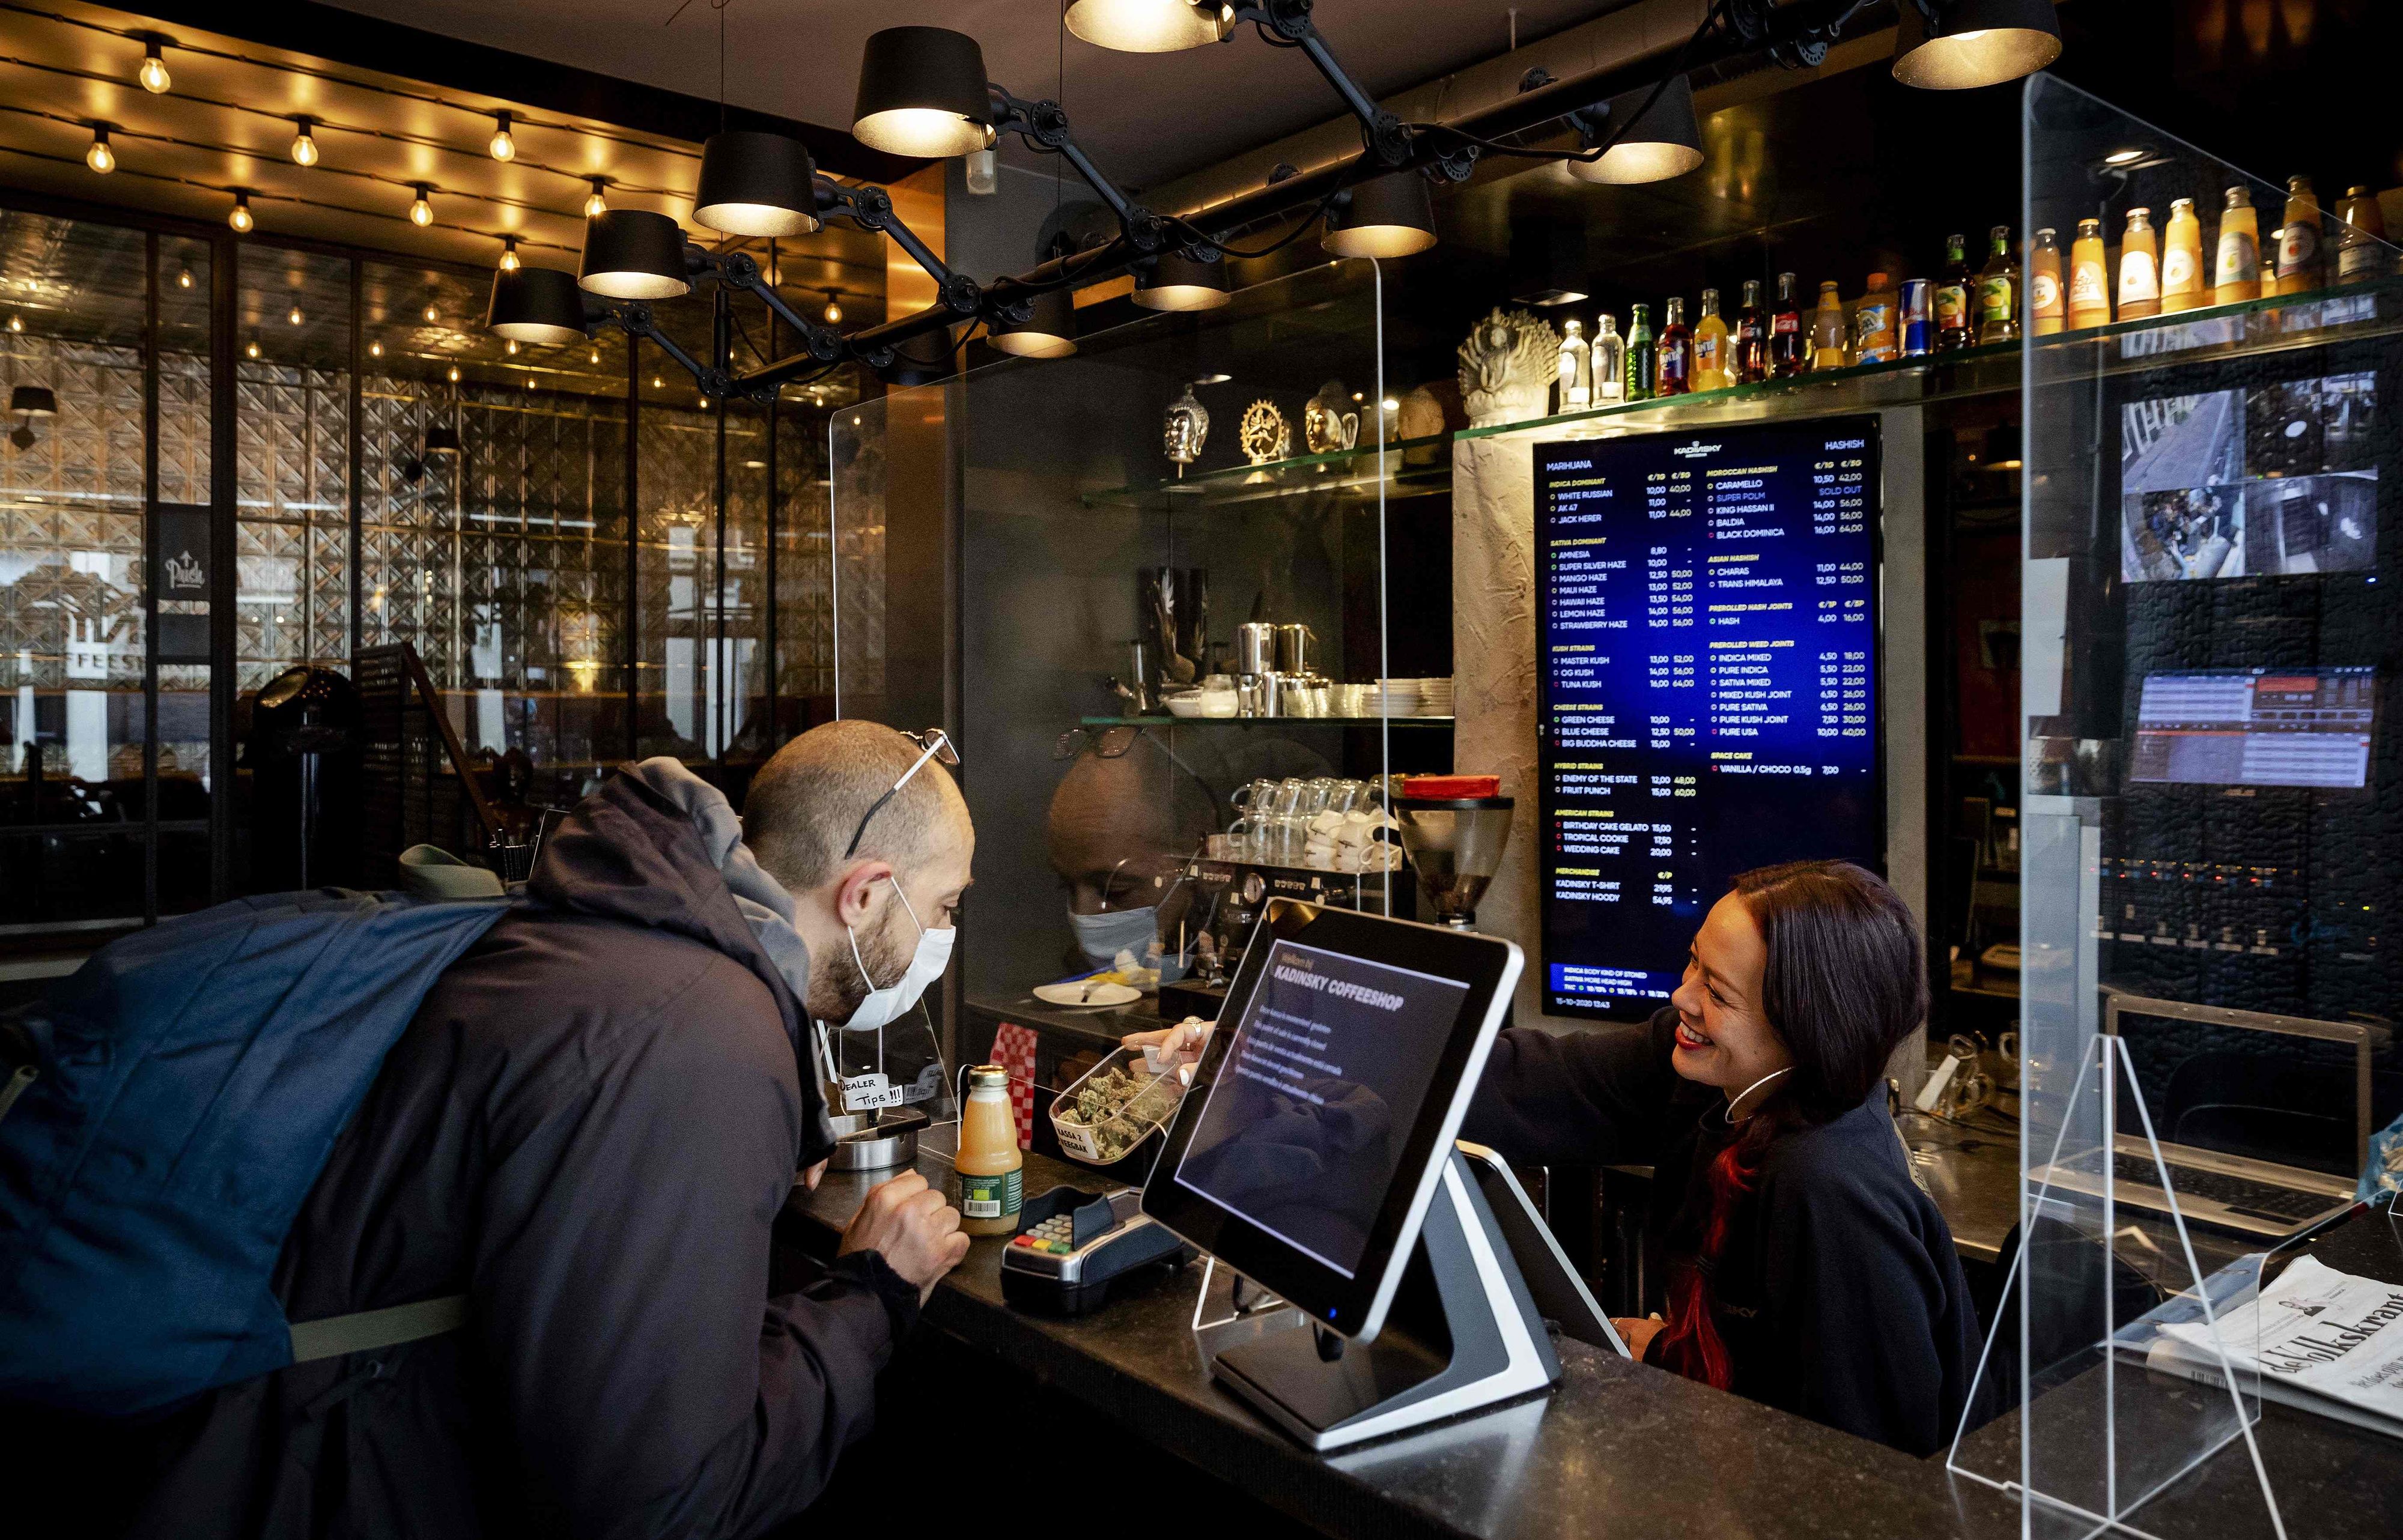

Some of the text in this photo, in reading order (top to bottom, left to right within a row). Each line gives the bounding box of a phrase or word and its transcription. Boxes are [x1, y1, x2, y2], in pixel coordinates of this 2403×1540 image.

[1825, 440, 1864, 450] HASHISH
[1546, 460, 1592, 471] MARIHUANA
[1716, 473, 1862, 490] CARAMELLO 10,50 42,00
[1558, 492, 1581, 500] WHITE
[1582, 490, 1612, 499] RUSSIAN
[1647, 486, 1666, 494] 10,00
[1716, 493, 1741, 502] SUPER
[1844, 486, 1862, 494] OUT
[1737, 505, 1768, 513] HASSAN
[1814, 500, 1835, 509] 14,00
[1578, 514, 1602, 523] HERER
[1669, 509, 1692, 517] 44,00
[1716, 518, 1745, 527] BALDIA
[1814, 513, 1835, 522] 14,00
[1717, 524, 1863, 539] BLACK DOMINICA 16,00 64,00
[1559, 551, 1590, 559] AMNESIA
[1583, 562, 1606, 570] SILVER
[1648, 559, 1667, 568] 10,00
[1817, 564, 1836, 572] 11,00
[1839, 563, 1864, 571] 44,00
[1745, 578, 1783, 587] HIMALAYA
[1816, 577, 1836, 585] 12,50
[1818, 614, 1836, 623] 4,00
[1817, 728, 1838, 736] 10,00
[1563, 822, 1598, 830] BIRTHDAY
[1564, 833, 1599, 841] TROPICAL
[1564, 845, 1599, 853] WEDDING
[1556, 880, 1620, 890] KADINSKY T-SHIRT
[1556, 891, 1620, 902] KADINSKY HOODY
[1274, 965, 1404, 1011] KADINSKY COFFEESHOP
[839, 1079, 876, 1091] DEALER
[855, 1093, 886, 1106] Tips
[1057, 1128, 1077, 1140] KASSA
[2262, 1293, 2403, 1363] Volkskrant
